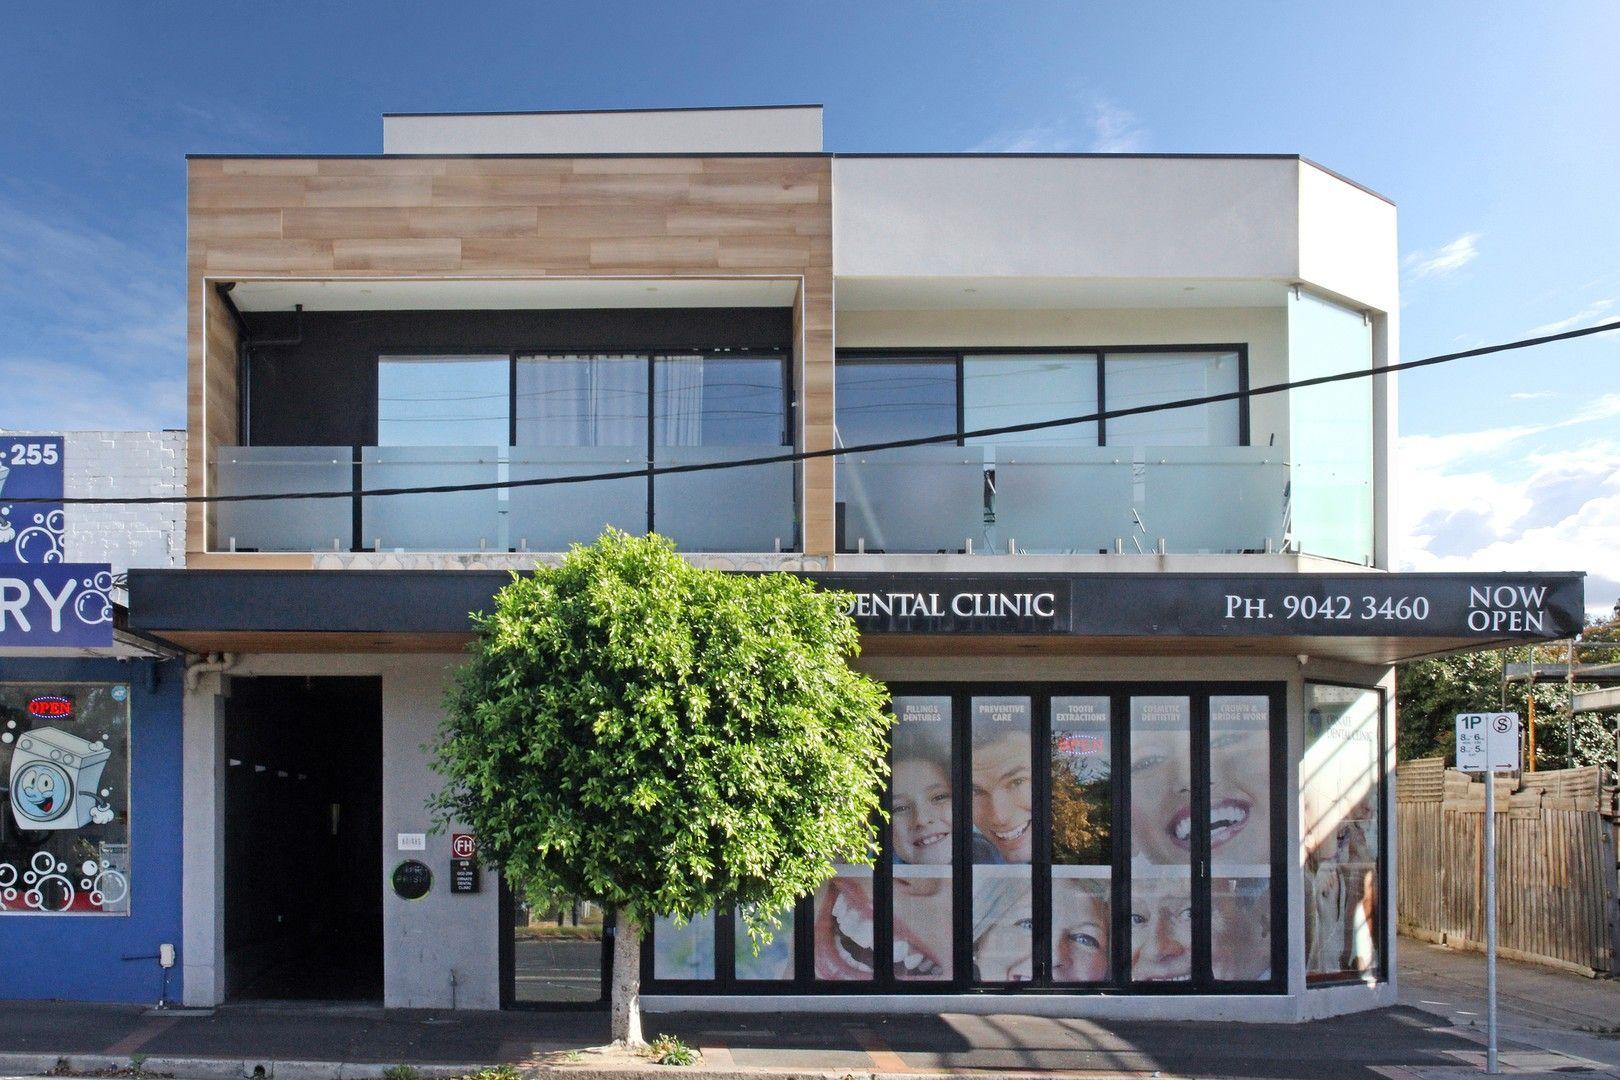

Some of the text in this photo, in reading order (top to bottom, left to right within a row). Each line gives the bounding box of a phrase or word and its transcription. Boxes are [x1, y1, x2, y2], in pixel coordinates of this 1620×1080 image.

[11, 444, 58, 465] 255
[1469, 586, 1547, 608] NOW
[951, 593, 1055, 617] CLINIC
[1225, 595, 1429, 620] PH. 9042 3460
[1467, 610, 1544, 632] OPEN
[29, 701, 72, 715] OPEN
[906, 705, 938, 714] FILLINGS
[979, 705, 1024, 713] PREVENTIVE
[1068, 705, 1094, 713] TOOTH
[1142, 704, 1180, 713] COSMETIC
[1221, 704, 1252, 712] CROWN
[903, 713, 941, 722] DENTURES
[992, 713, 1012, 722] CARE
[1056, 713, 1106, 722] EXTRACTIONS
[1142, 712, 1180, 722] DENTISTRY
[1212, 712, 1267, 720] BRIDGE WORK
[1462, 716, 1482, 729] 1P
[1058, 737, 1104, 752] OPEN
[457, 840, 472, 852] FH
